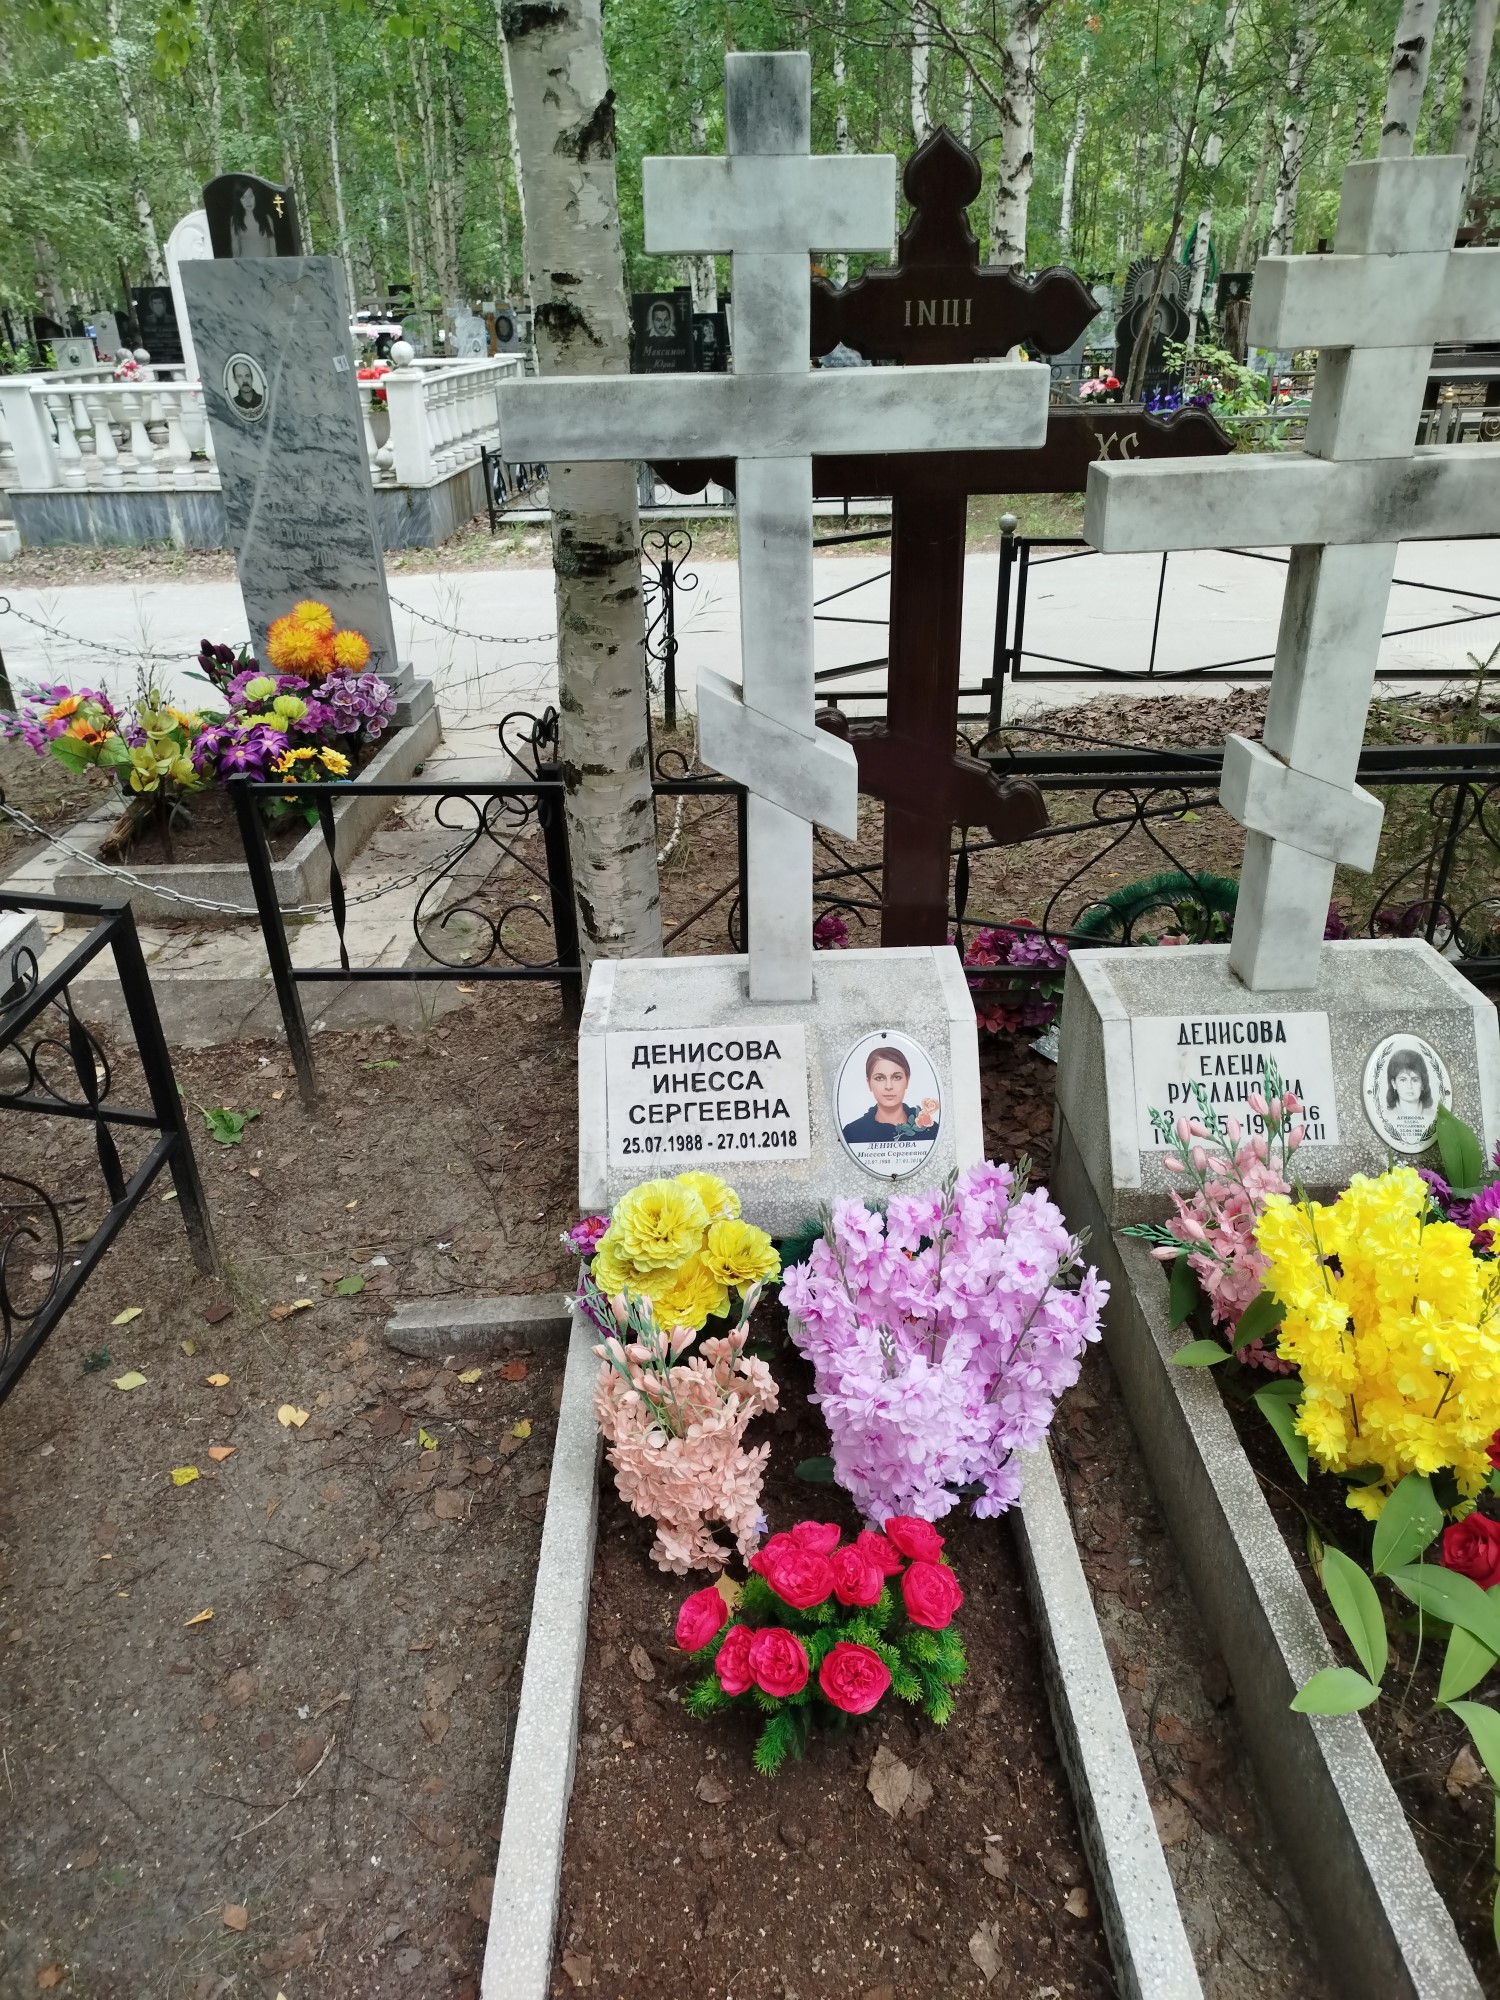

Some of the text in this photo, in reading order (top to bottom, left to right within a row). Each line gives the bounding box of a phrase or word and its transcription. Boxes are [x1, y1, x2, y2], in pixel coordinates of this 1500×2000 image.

[1177, 1019, 1287, 1046] ДЕНИСОВА
[631, 1039, 782, 1069] ДЕНИСОВА
[1200, 1053, 1265, 1076] ЕЛЕНА
[652, 1070, 765, 1094] ИНЕССА
[628, 1098, 791, 1125] СЕРГЕЕВНА
[1301, 1105, 1321, 1121] 16
[622, 1134, 703, 1154] 25.07.1988
[717, 1130, 797, 1150] 27.01.2018
[866, 1141, 917, 1150] ДЕНИСОВА
[887, 1150, 927, 1158] Сергеевна
